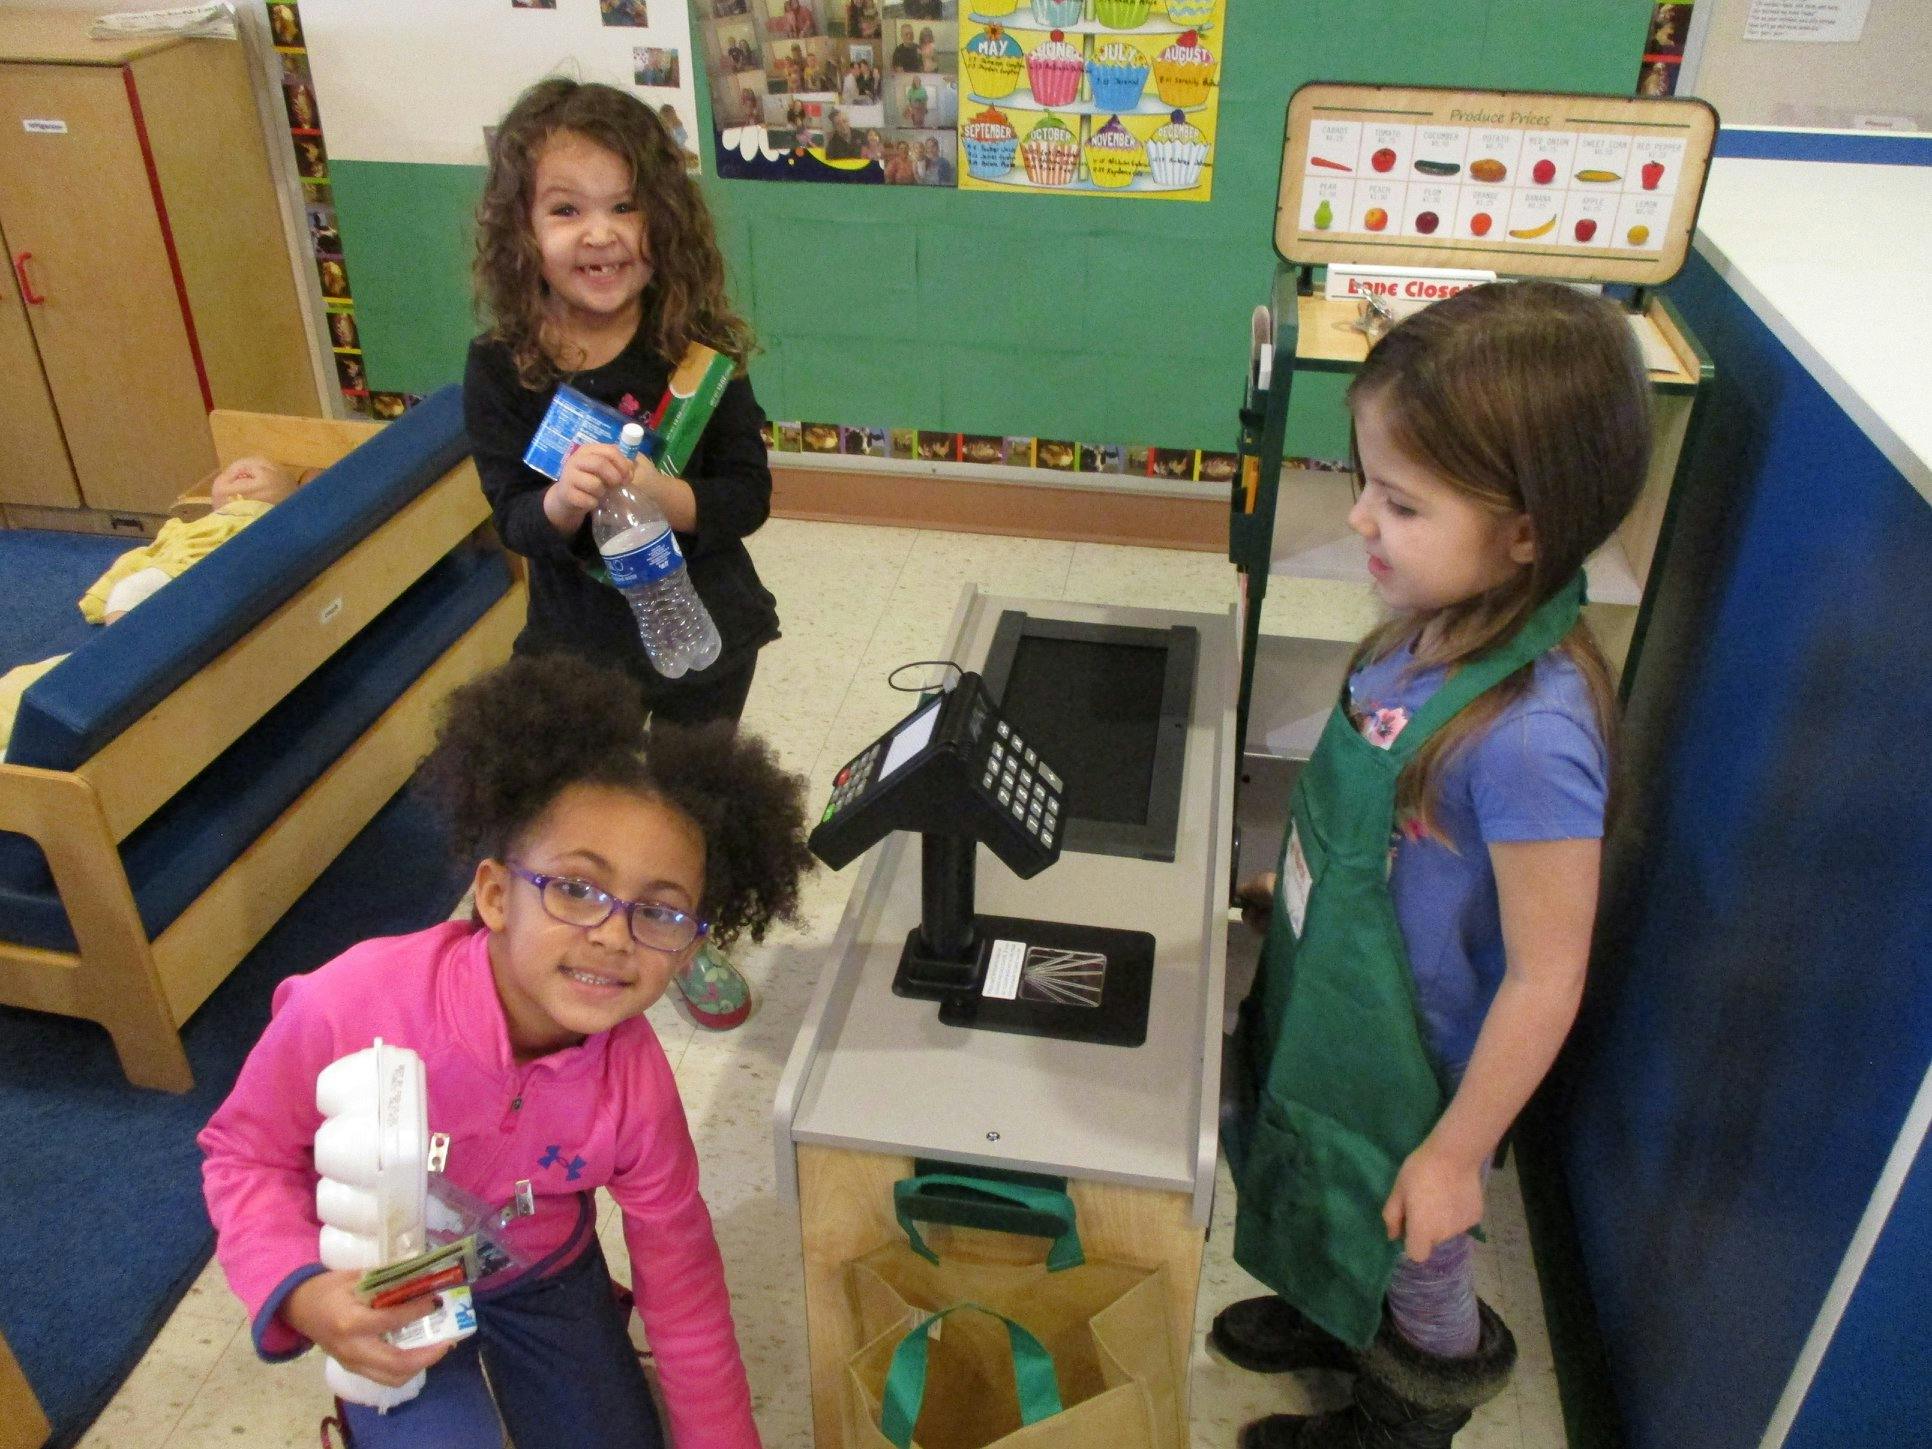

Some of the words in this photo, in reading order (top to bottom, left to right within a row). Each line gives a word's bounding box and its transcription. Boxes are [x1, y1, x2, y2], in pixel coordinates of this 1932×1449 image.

[978, 40, 1008, 56] MAY
[1099, 44, 1136, 61] JULY
[1164, 47, 1207, 61] AUGUST
[1450, 108, 1505, 123] Produce
[1510, 110, 1551, 126] Prices
[964, 123, 1012, 139] SEPTEMBER
[1030, 127, 1072, 141] OCTOBER
[1091, 132, 1136, 147] NOVEMBER
[1405, 281, 1473, 299] Close
